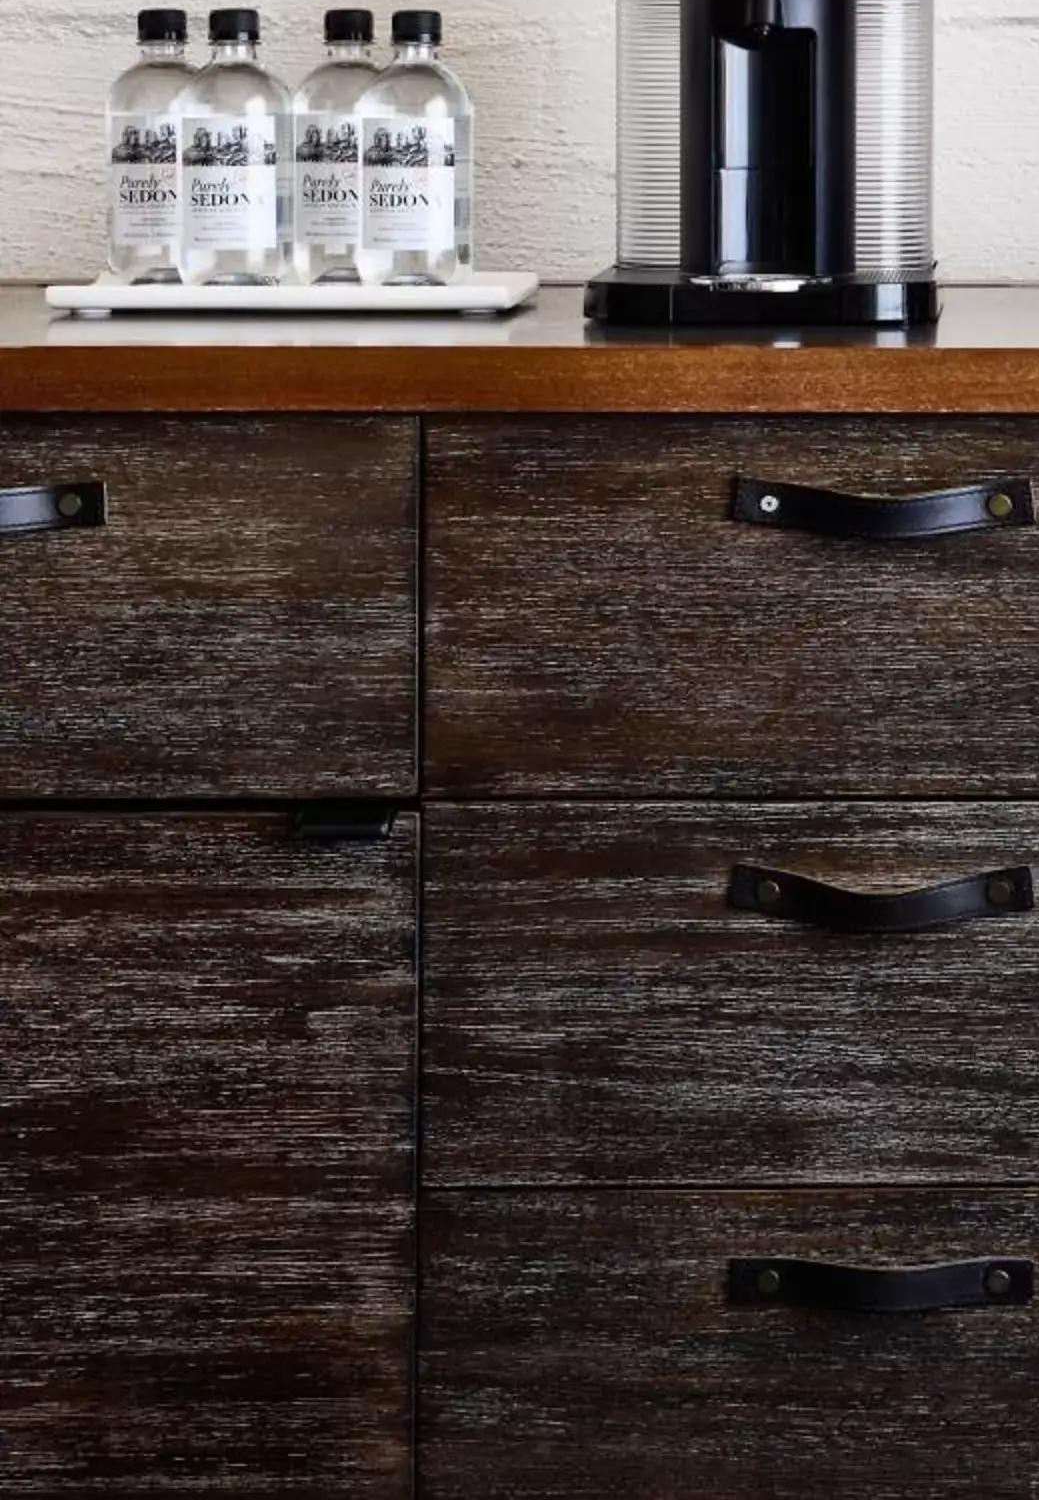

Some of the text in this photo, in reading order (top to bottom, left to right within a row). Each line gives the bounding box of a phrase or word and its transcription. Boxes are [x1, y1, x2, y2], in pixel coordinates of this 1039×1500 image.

[118, 173, 162, 190] Purely
[190, 176, 232, 193] Purely
[302, 172, 341, 189] Purely
[369, 177, 411, 194] Purely
[119, 189, 178, 204] SEDON
[303, 188, 360, 204] SEDON
